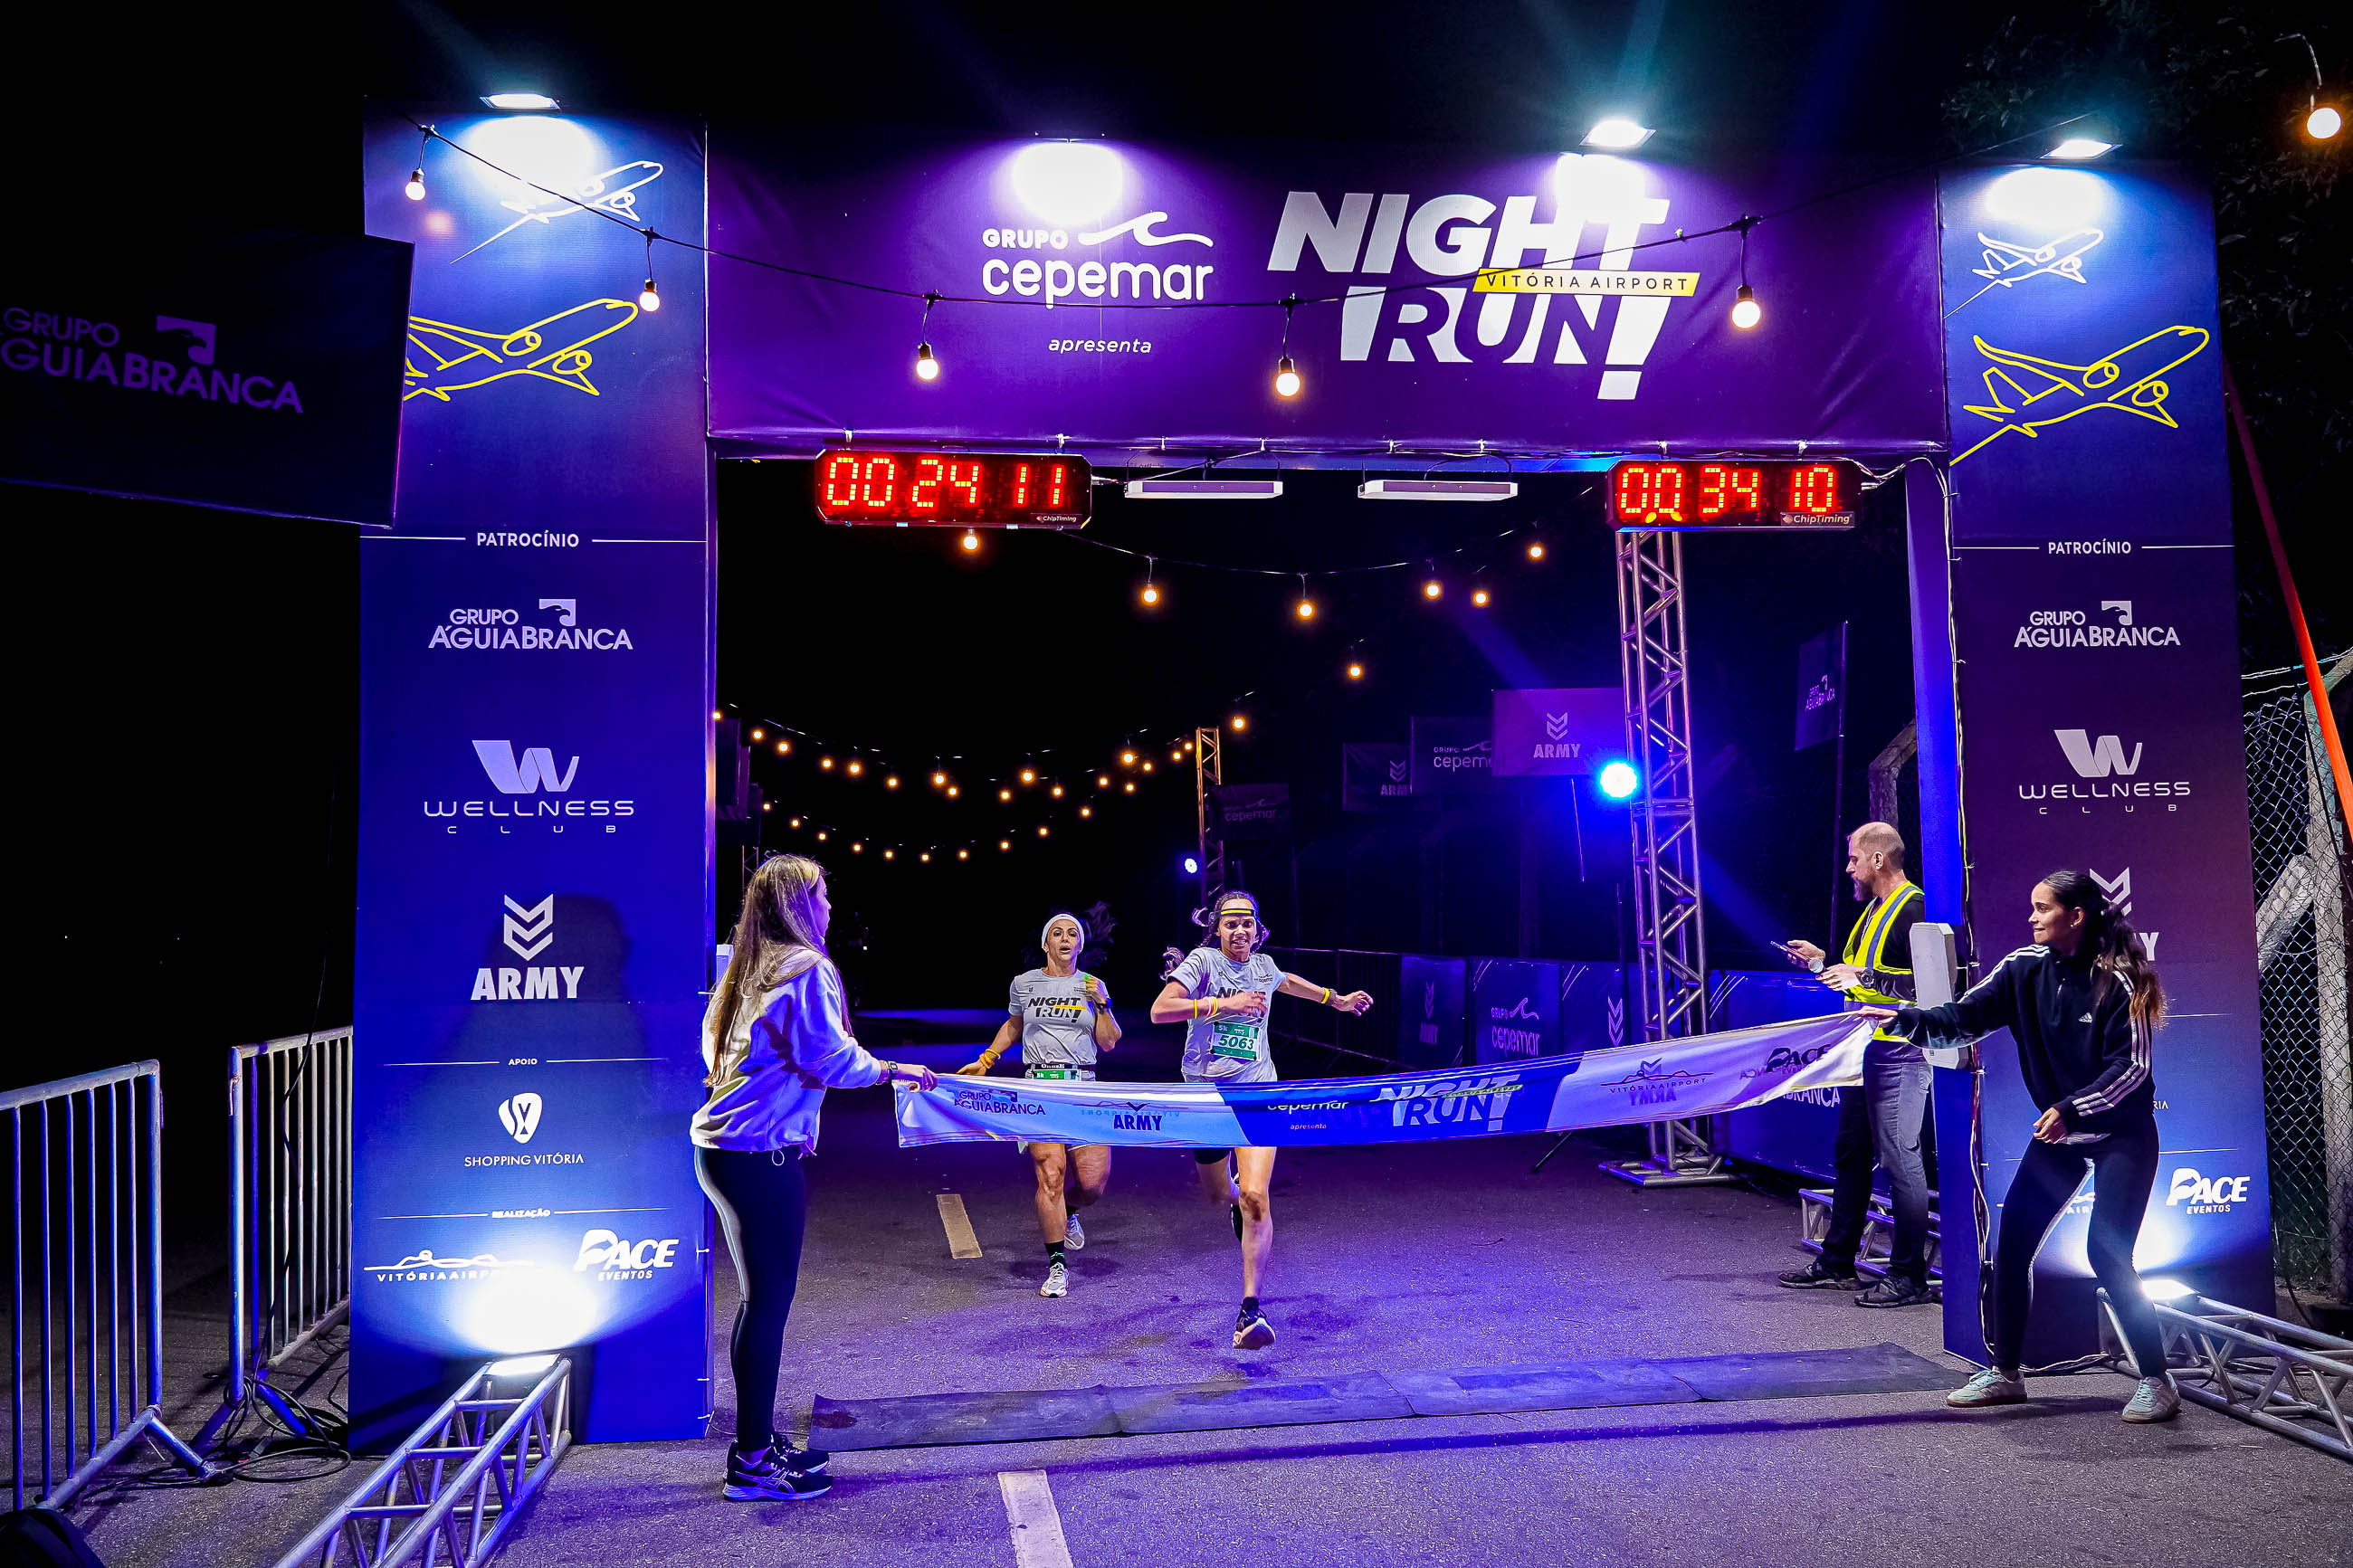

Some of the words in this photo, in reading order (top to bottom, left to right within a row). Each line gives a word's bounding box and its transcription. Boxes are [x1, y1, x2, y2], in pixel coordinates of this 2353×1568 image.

[982, 228, 1069, 250] GRUPO
[1267, 191, 1671, 276] NIGHT
[982, 259, 1215, 309] cepemar
[1486, 271, 1580, 289] VITÓRIA
[1590, 278, 1689, 290] AIRPORT
[4, 308, 120, 347] GRUPO
[1048, 337, 1152, 355] apresenta
[0, 337, 304, 413] GUIABRANCA
[826, 456, 895, 508] 00
[911, 459, 979, 508] 24
[1017, 466, 1062, 505] 11
[1620, 467, 1682, 514] 00
[1702, 467, 1758, 513] 34
[1794, 467, 1834, 513] 10
[1043, 515, 1077, 523] ChipTiming
[1793, 515, 1851, 525] ChipTiming
[477, 530, 579, 547] PATROCÍNIO
[2048, 538, 2131, 555] PATROCÍNIO
[450, 608, 519, 625] GRUPO
[2029, 611, 2086, 626] GRUPO
[428, 625, 634, 650] ÁGUIABRANCA
[2014, 626, 2181, 648] ÁGUIABRANCA
[1533, 744, 1581, 758] ARMY
[1434, 756, 1492, 773] cepem
[2019, 782, 2191, 799] WELLNESS
[424, 800, 634, 816] WELLNESS
[471, 966, 585, 1001] ARMY
[1028, 997, 1081, 1008] NIGHT
[1218, 1035, 1254, 1050] 5063
[1492, 1026, 1540, 1058] cepemar
[508, 1058, 538, 1066] APOIO
[959, 1090, 992, 1101] GRUPO
[1113, 1114, 1163, 1131] ARMY
[1291, 1123, 1327, 1131] apresenta
[464, 1155, 531, 1167] SHOPPING
[534, 1152, 585, 1165] VITÓRIA
[2166, 1167, 2251, 1206] PACE
[2186, 1204, 2231, 1215] EVENTOS
[573, 1229, 680, 1272] PACE
[598, 1269, 653, 1282] EVENTOS
